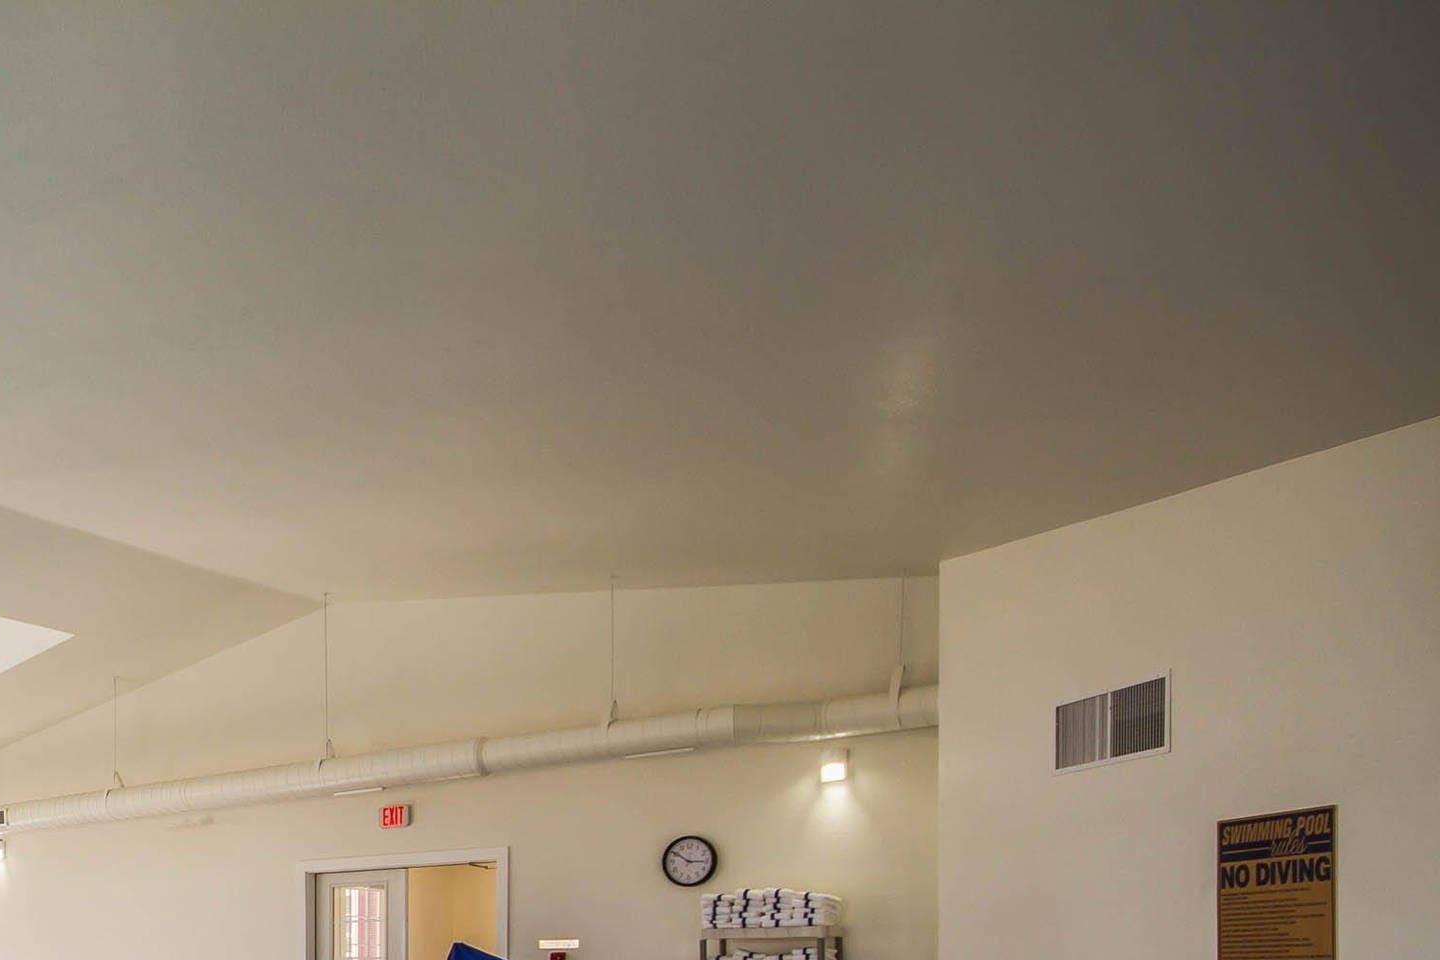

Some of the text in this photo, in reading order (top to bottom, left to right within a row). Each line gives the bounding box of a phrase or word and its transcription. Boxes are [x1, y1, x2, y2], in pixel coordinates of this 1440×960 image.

[383, 806, 405, 826] EXIT
[1222, 813, 1332, 847] SWIMMING POOL
[1221, 856, 1332, 889] NO DIVING
